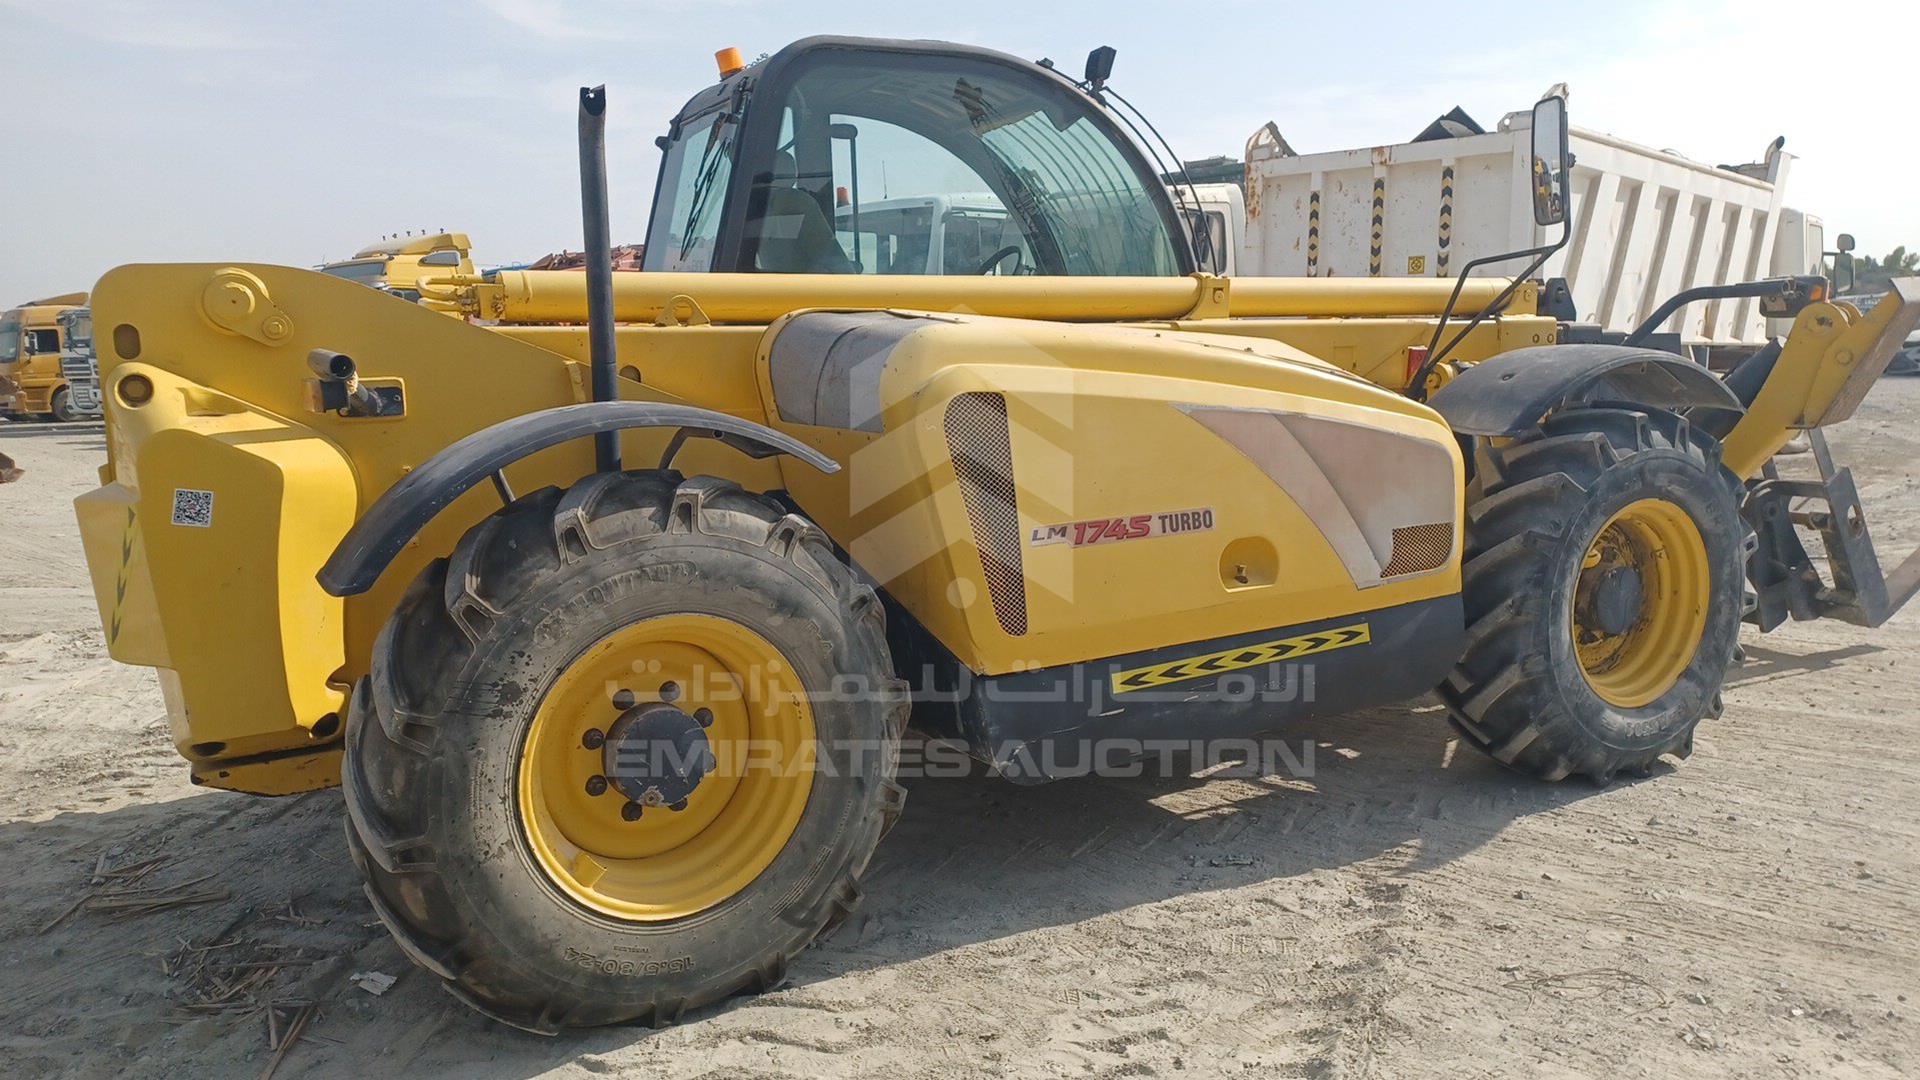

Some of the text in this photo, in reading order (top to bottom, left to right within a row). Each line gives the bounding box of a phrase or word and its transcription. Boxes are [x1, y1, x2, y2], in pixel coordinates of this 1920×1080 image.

[1031, 510, 1213, 545] LM 1745 TURBO
